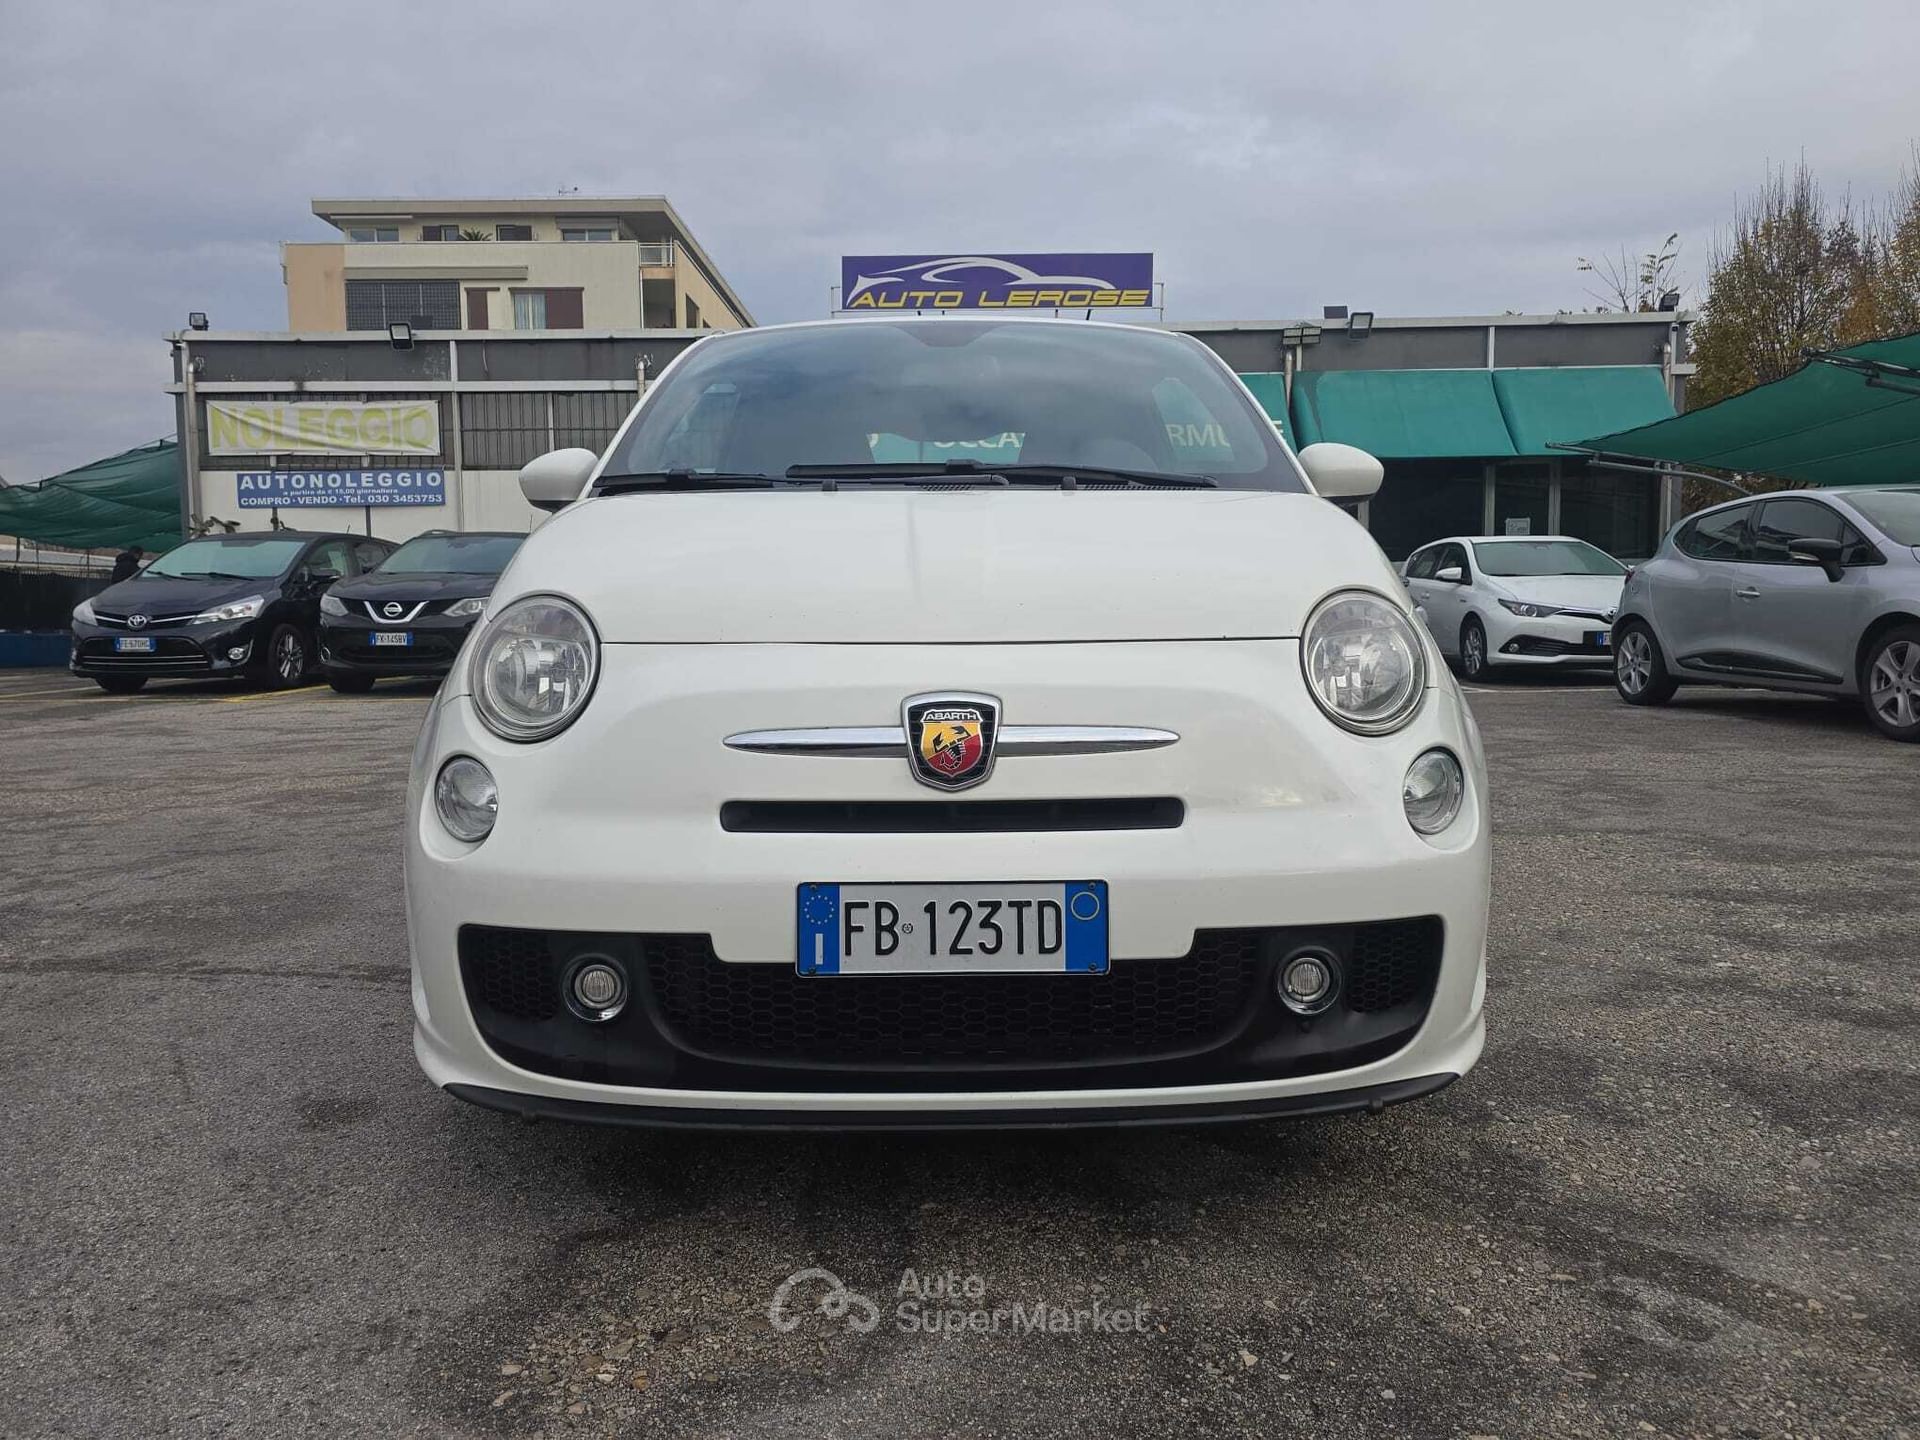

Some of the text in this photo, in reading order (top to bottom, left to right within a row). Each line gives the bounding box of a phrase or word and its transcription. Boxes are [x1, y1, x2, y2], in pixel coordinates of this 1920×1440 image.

[851, 289, 1150, 308] AUTO LEROSE
[210, 407, 434, 449] NOLEGGIO
[240, 472, 442, 490] AUTONOLEGGIO
[240, 496, 291, 506] COMPRO
[297, 495, 338, 505] VENDO
[344, 495, 365, 503] Tel.
[367, 495, 390, 503] 030
[926, 712, 977, 721] ABARTH
[844, 900, 900, 956] FB
[923, 900, 1063, 956] 123TD
